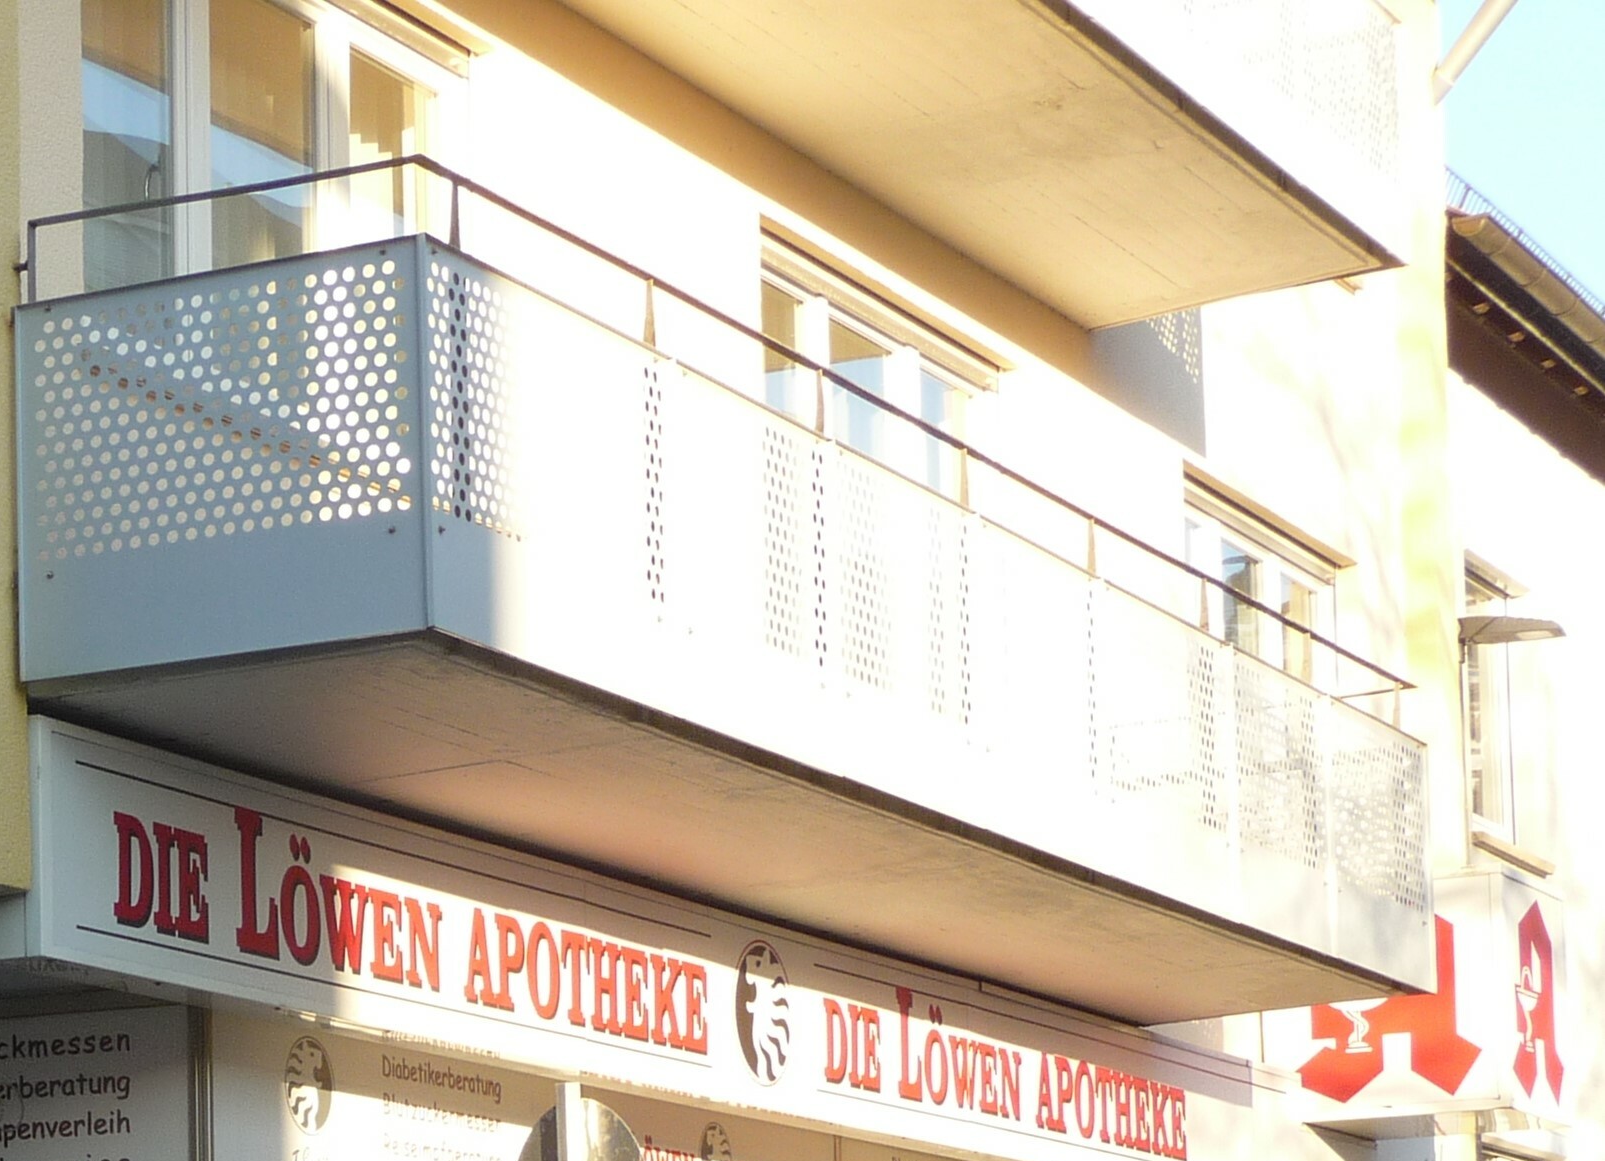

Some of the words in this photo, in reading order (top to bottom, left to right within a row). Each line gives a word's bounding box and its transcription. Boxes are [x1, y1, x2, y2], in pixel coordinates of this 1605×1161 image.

[112, 810, 210, 943] DIE
[234, 807, 442, 993] LÖWEN
[463, 907, 708, 1055] APOTHEKE
[382, 1054, 502, 1104] Diabetikerberatung
[822, 995, 881, 1092] DIE
[894, 986, 1021, 1122] LÖWEN
[1036, 1052, 1187, 1161] APOTHEKE
